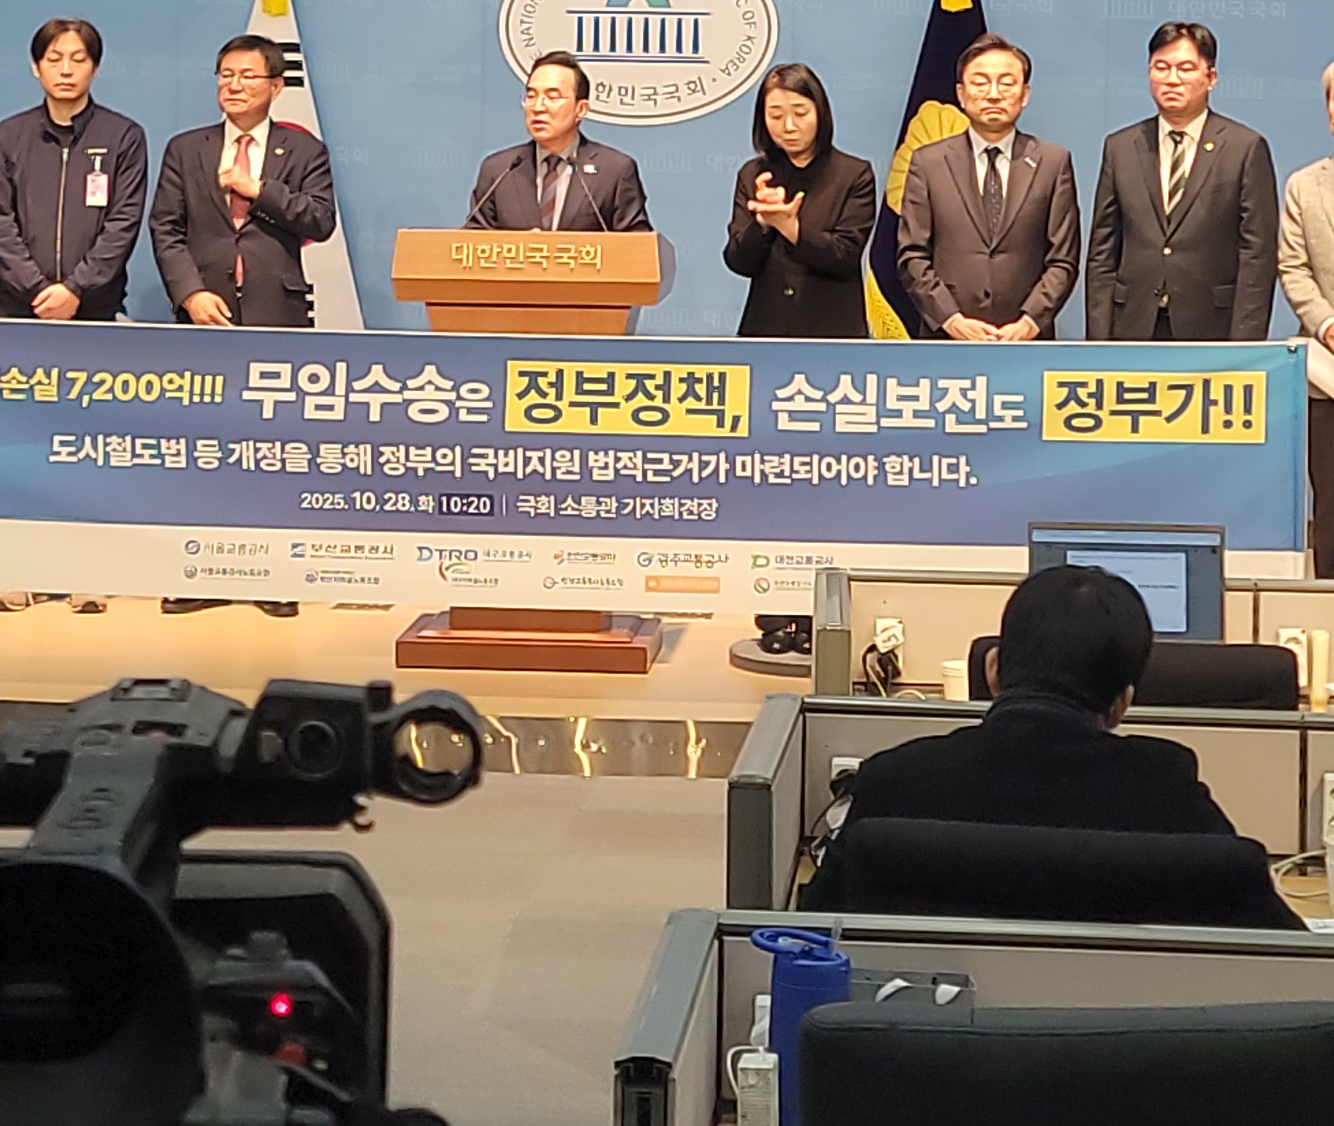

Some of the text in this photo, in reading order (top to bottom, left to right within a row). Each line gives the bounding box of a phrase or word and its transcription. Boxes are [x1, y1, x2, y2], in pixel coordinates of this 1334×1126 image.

[741, 10, 758, 30] OF
[719, 35, 757, 79] KOREA
[595, 76, 708, 109] 한민국국회
[451, 242, 602, 272] 대한민국국회
[64, 368, 224, 409] 7,200억!!!
[241, 360, 495, 424] 무임수송은
[512, 365, 747, 437] 정부정책,
[770, 373, 1029, 434] 손실보전도
[1053, 378, 1257, 434] 정부가!!
[48, 433, 980, 490] 도시철도법 등 개정을 통해 정부의 국비지원 법적근거가 마련되어야 합니다.
[300, 492, 349, 511] 2025.
[439, 496, 491, 514] 10:20
[516, 495, 719, 521] 국회 소통관 기자회견장
[310, 542, 396, 556] 부산교통공사
[415, 545, 479, 563] DTRO
[658, 553, 730, 569] 광주교통공사
